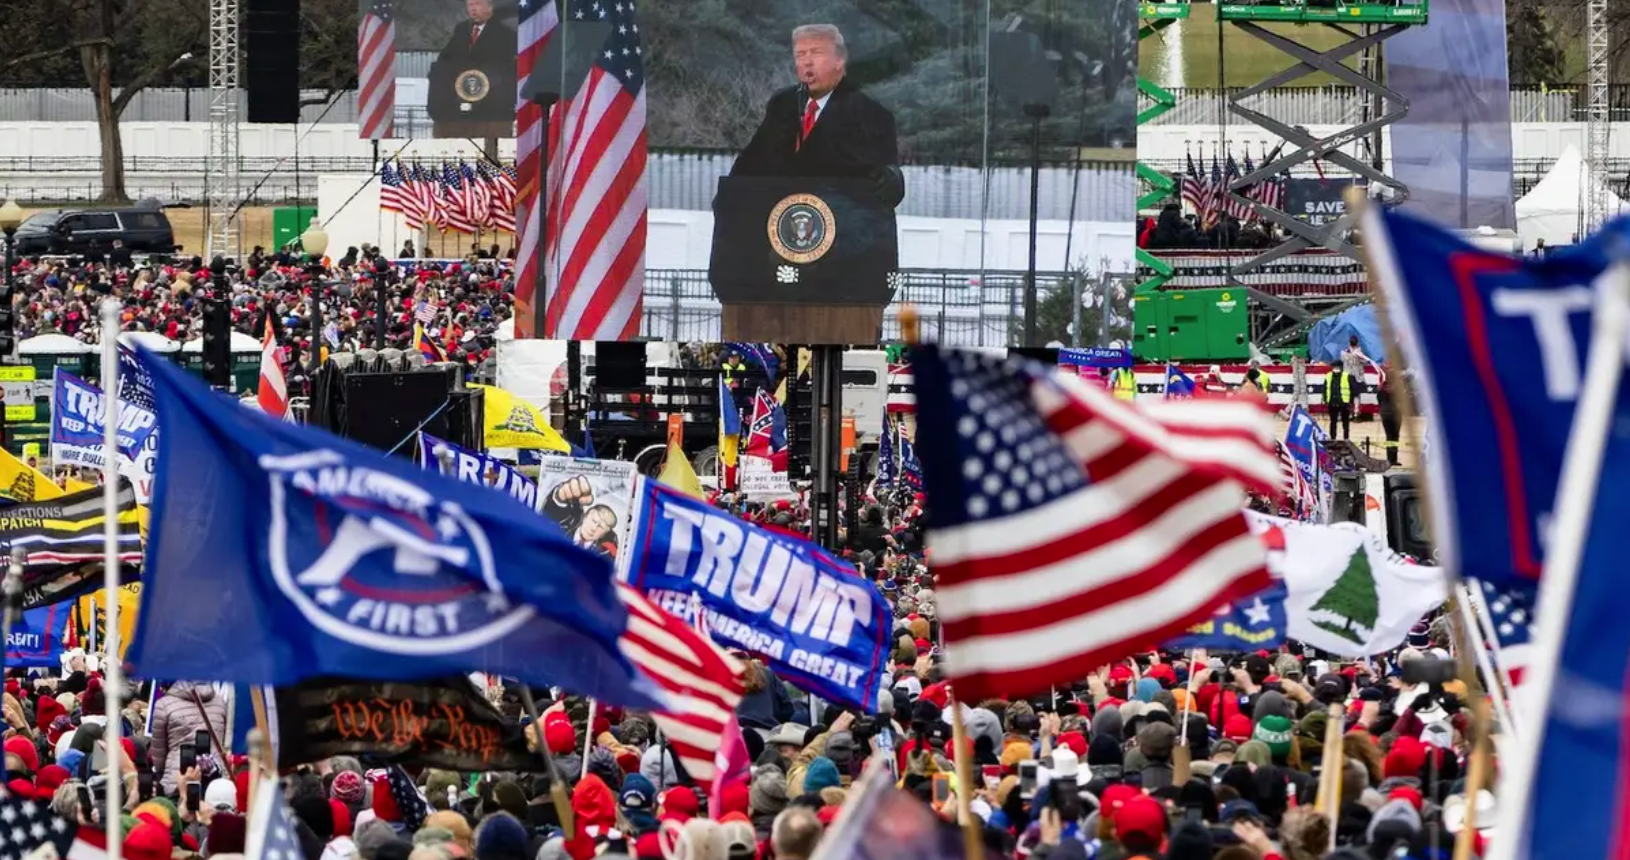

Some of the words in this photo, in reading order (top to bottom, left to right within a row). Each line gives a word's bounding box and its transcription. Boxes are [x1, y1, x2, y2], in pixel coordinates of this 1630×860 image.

[1305, 201, 1345, 214] SAVE
[63, 379, 156, 434] TRMP
[82, 453, 121, 471] BULLST
[431, 447, 538, 512] TRUM
[293, 466, 432, 519] AMECA
[663, 501, 872, 646] TRUMP
[5, 632, 39, 648] REAT!
[346, 598, 462, 636] FIRST
[701, 605, 785, 661] MERICA
[788, 648, 865, 689] GREAT
[432, 702, 500, 763] Peop
